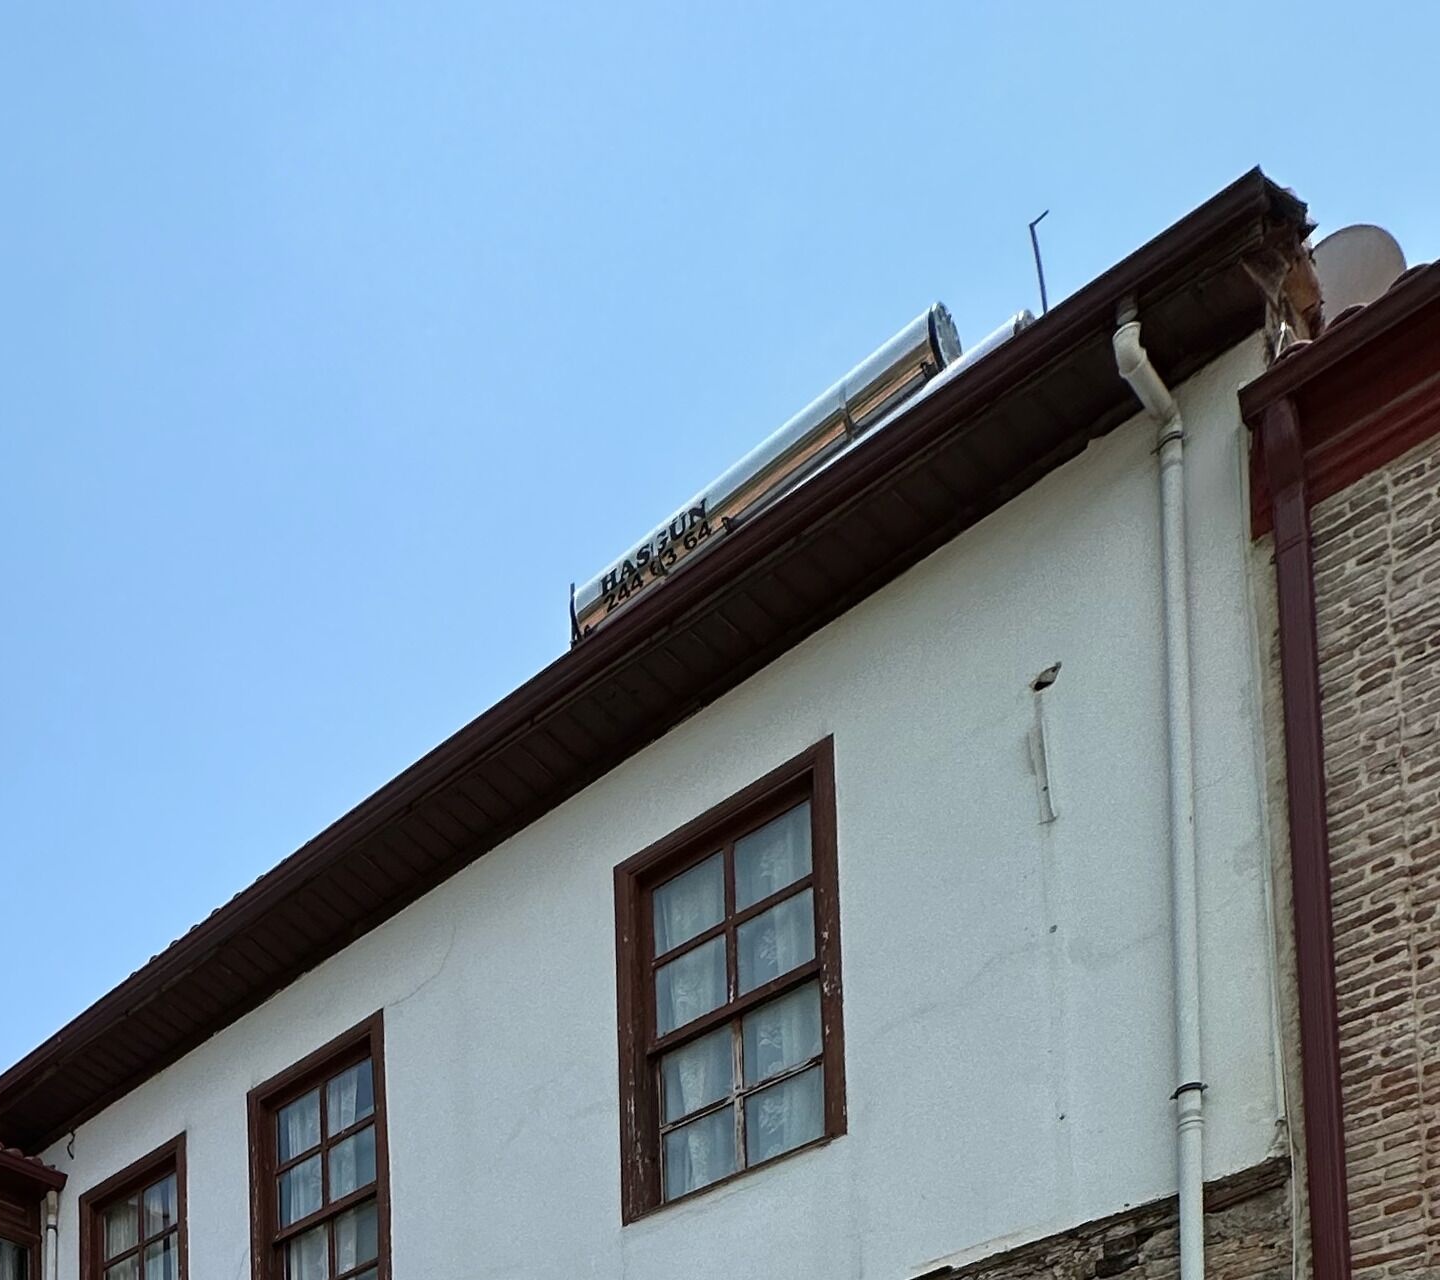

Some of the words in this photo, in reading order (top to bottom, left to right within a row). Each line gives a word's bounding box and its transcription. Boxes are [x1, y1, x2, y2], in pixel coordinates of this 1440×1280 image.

[601, 498, 707, 597] HASGÜN
[604, 573, 643, 612] 244
[683, 521, 712, 550] 64
